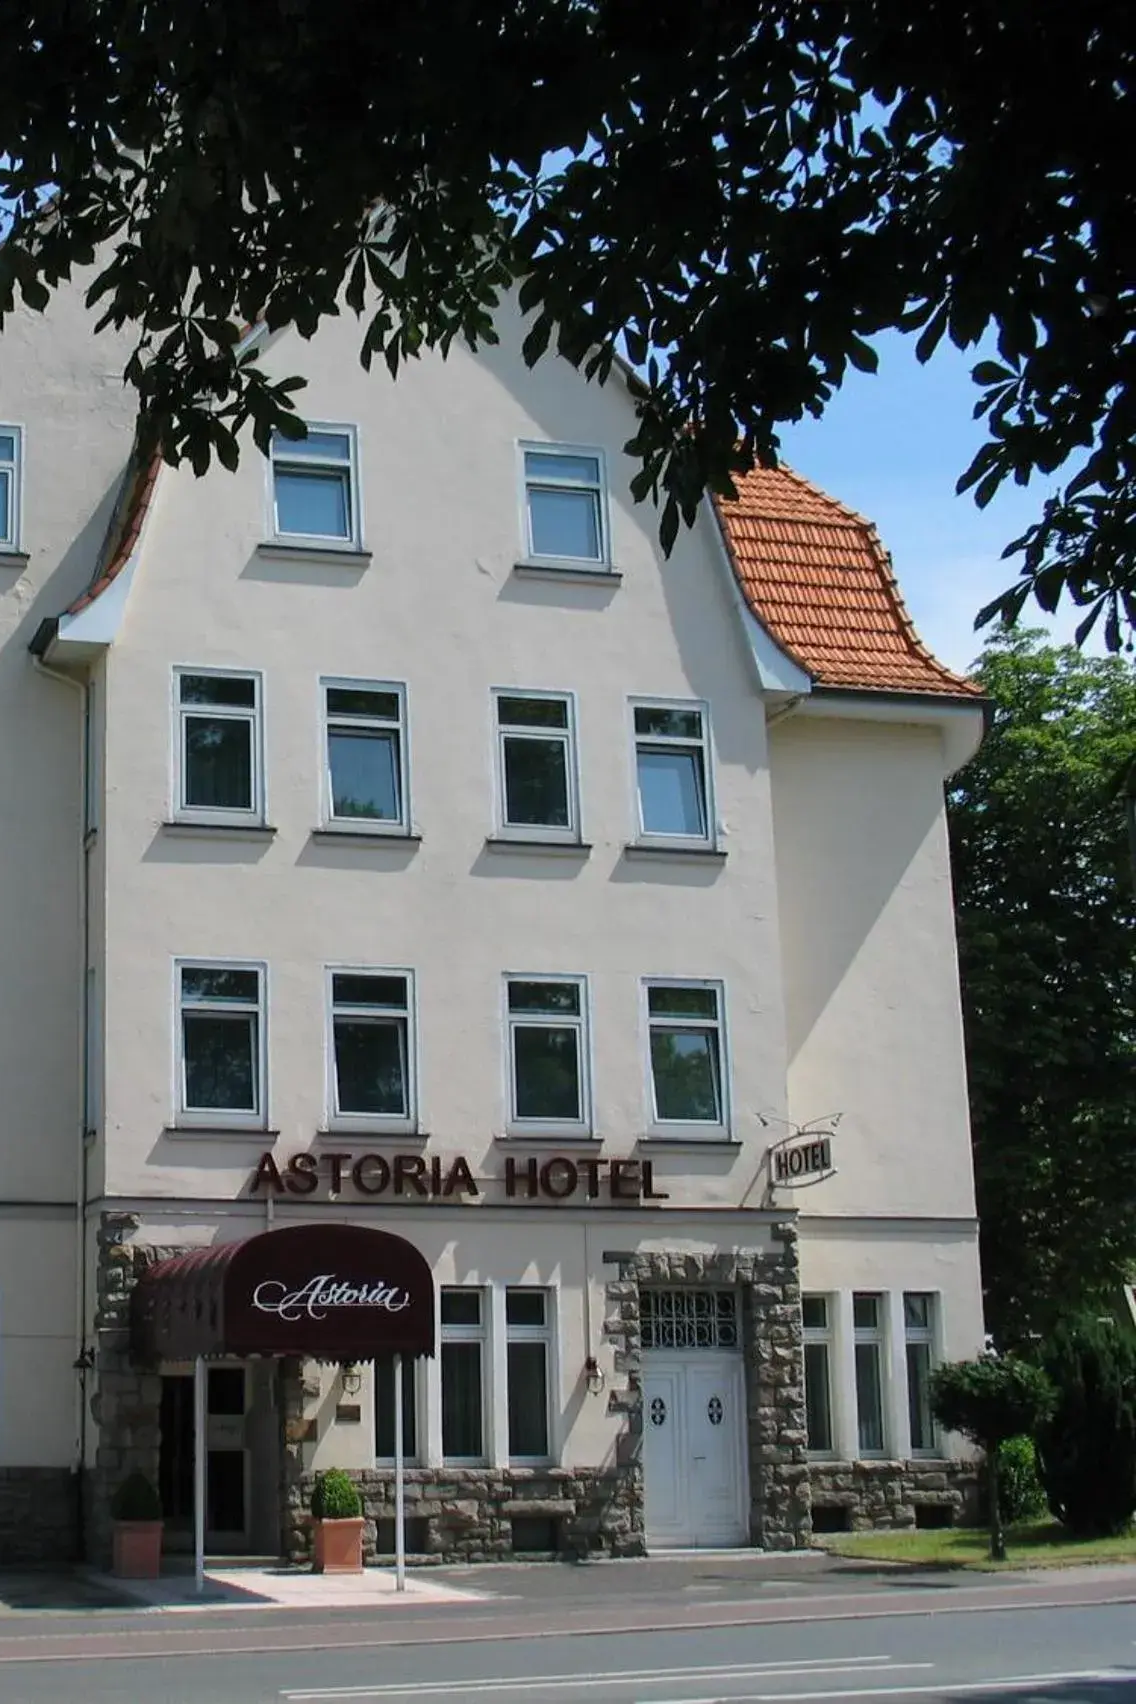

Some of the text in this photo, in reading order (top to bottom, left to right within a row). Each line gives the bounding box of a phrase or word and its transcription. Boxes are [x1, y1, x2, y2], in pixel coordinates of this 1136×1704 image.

[250, 1152, 670, 1199] ASTORIA HOTEL
[776, 1141, 831, 1179] HOTEL
[252, 1274, 410, 1321] Astoria
